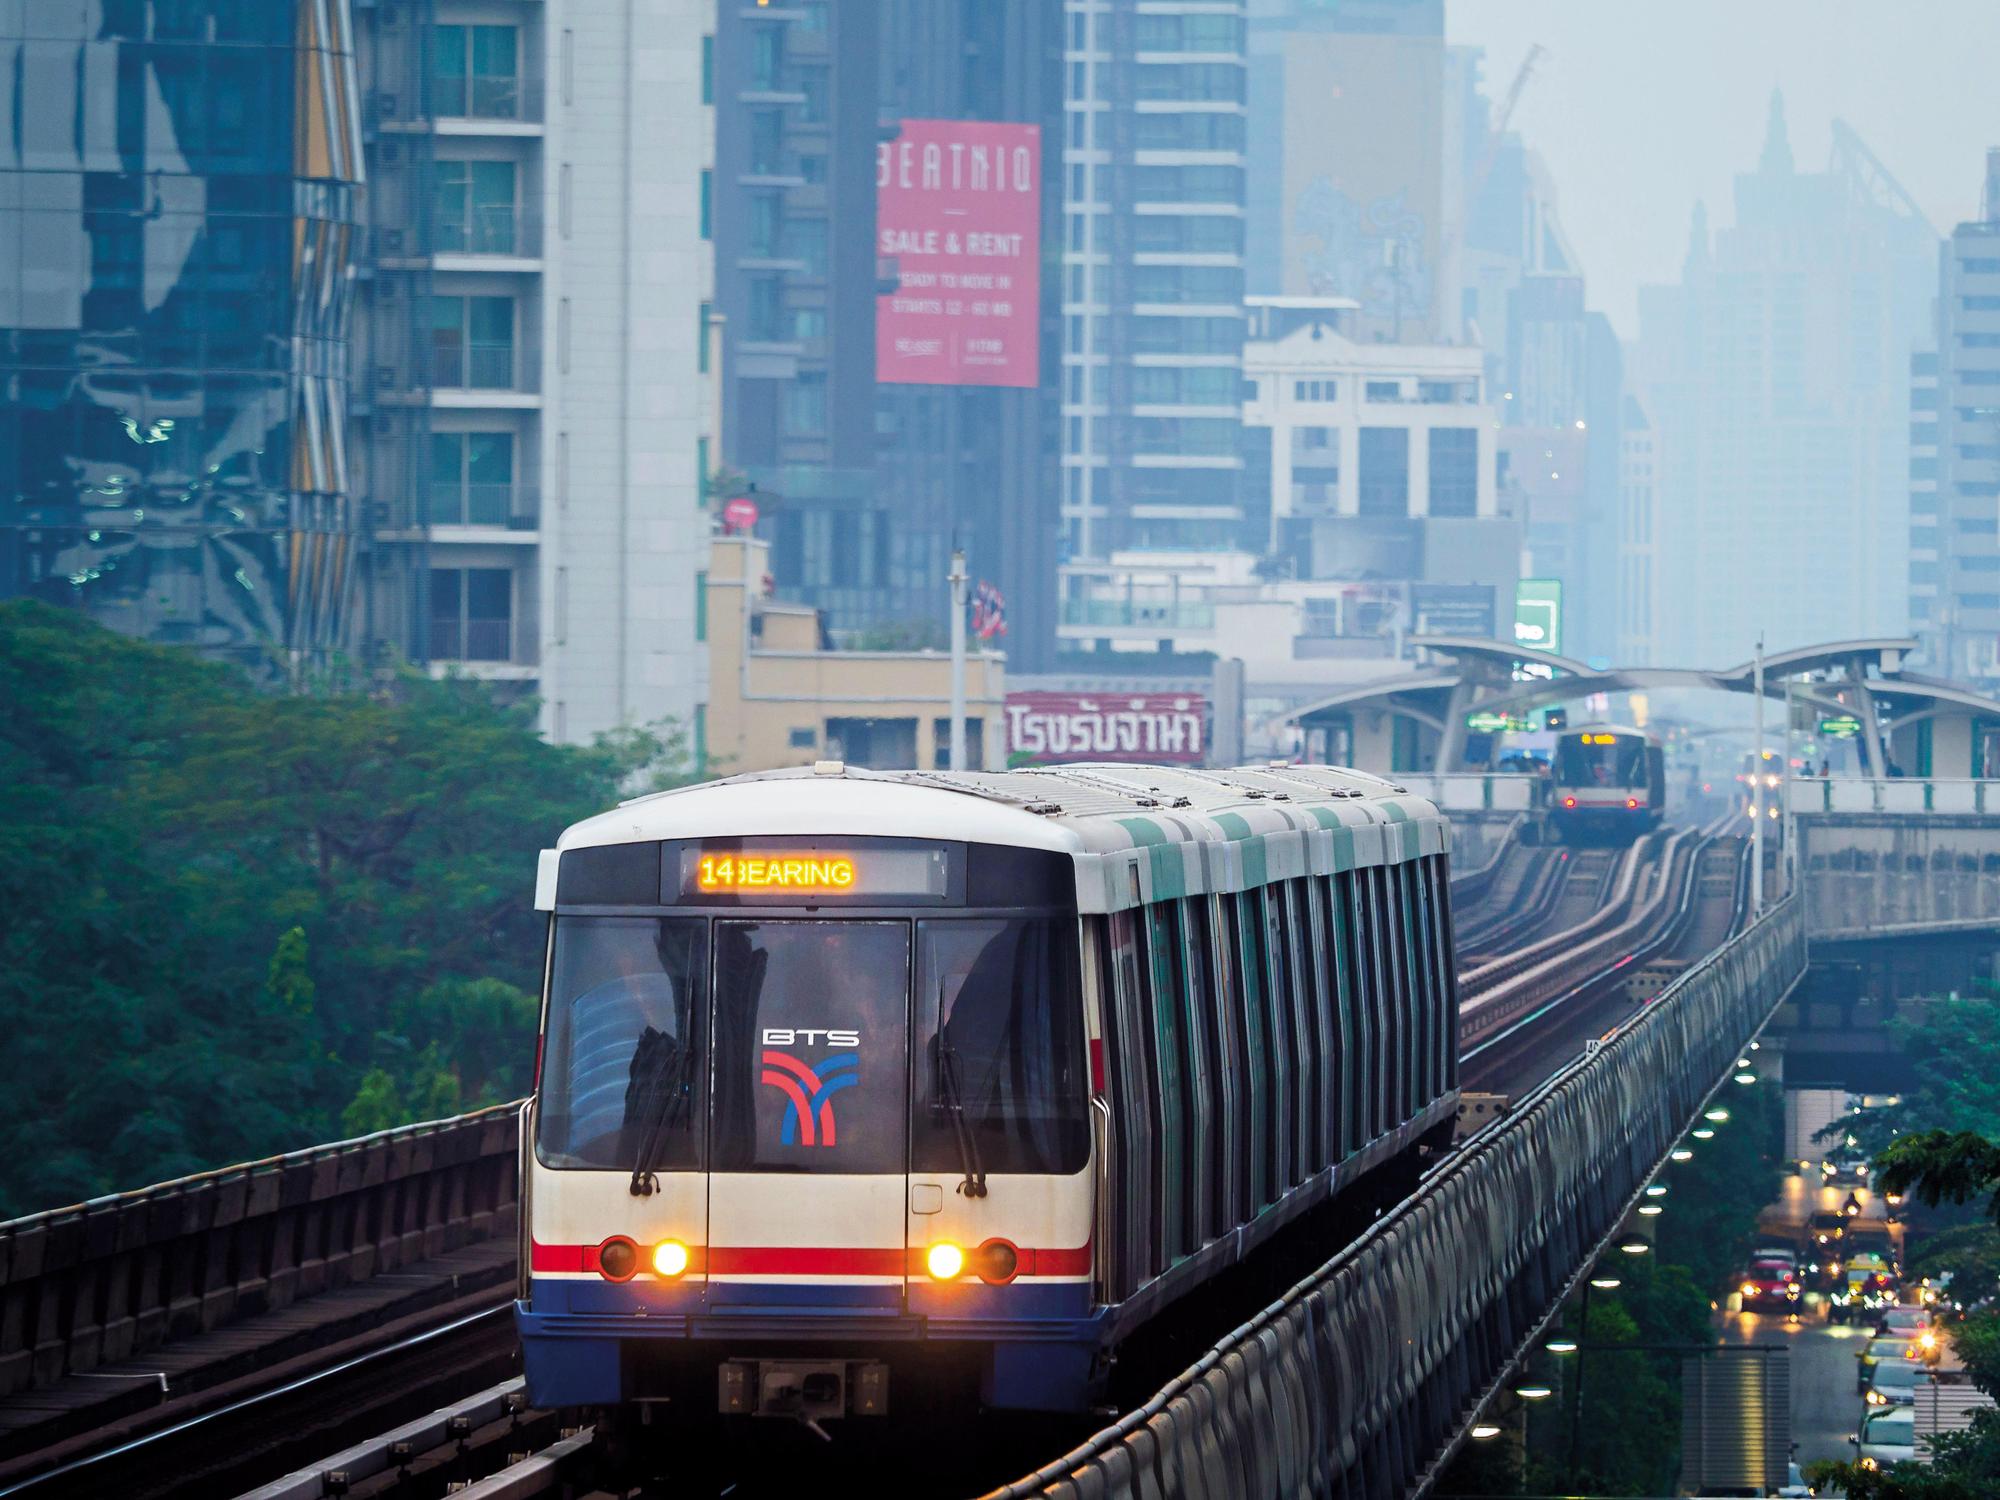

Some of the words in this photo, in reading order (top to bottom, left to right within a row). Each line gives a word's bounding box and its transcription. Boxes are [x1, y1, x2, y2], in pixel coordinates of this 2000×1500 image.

[880, 229, 939, 255] SALE
[944, 230, 962, 255] &
[966, 231, 1023, 256] RENT
[1006, 698, 1201, 753] โรงรับจำนำ
[701, 856, 735, 886] 14
[762, 1028, 860, 1047] BTS
